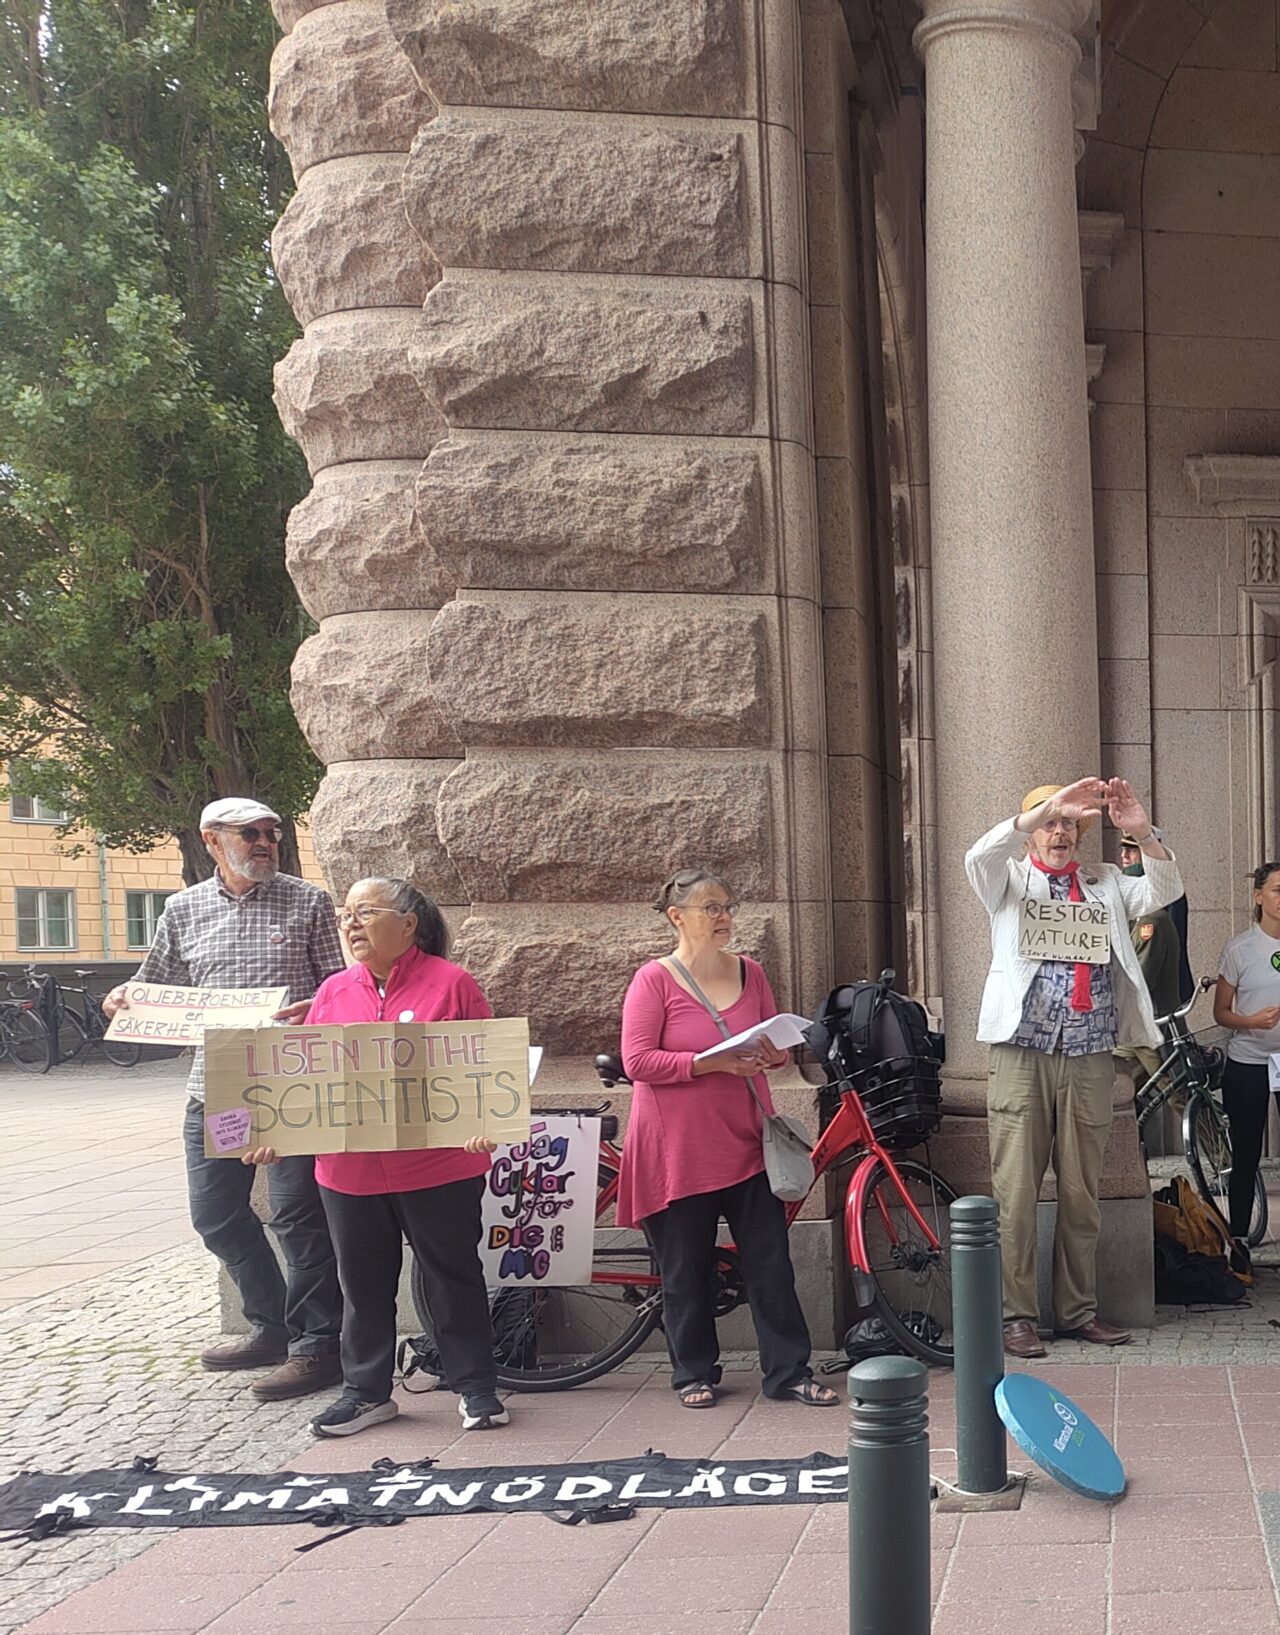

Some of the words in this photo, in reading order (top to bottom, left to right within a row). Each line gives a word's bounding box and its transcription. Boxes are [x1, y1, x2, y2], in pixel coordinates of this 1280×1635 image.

[1024, 899, 1109, 925] RESTORE
[1020, 928, 1109, 953] NATURE!
[131, 987, 277, 1005] OLJEBEROENDET
[247, 1033, 360, 1077] LISTEN
[371, 1037, 415, 1069] TO
[421, 1033, 490, 1068] THE
[242, 1070, 521, 1133] SCIENTISTS
